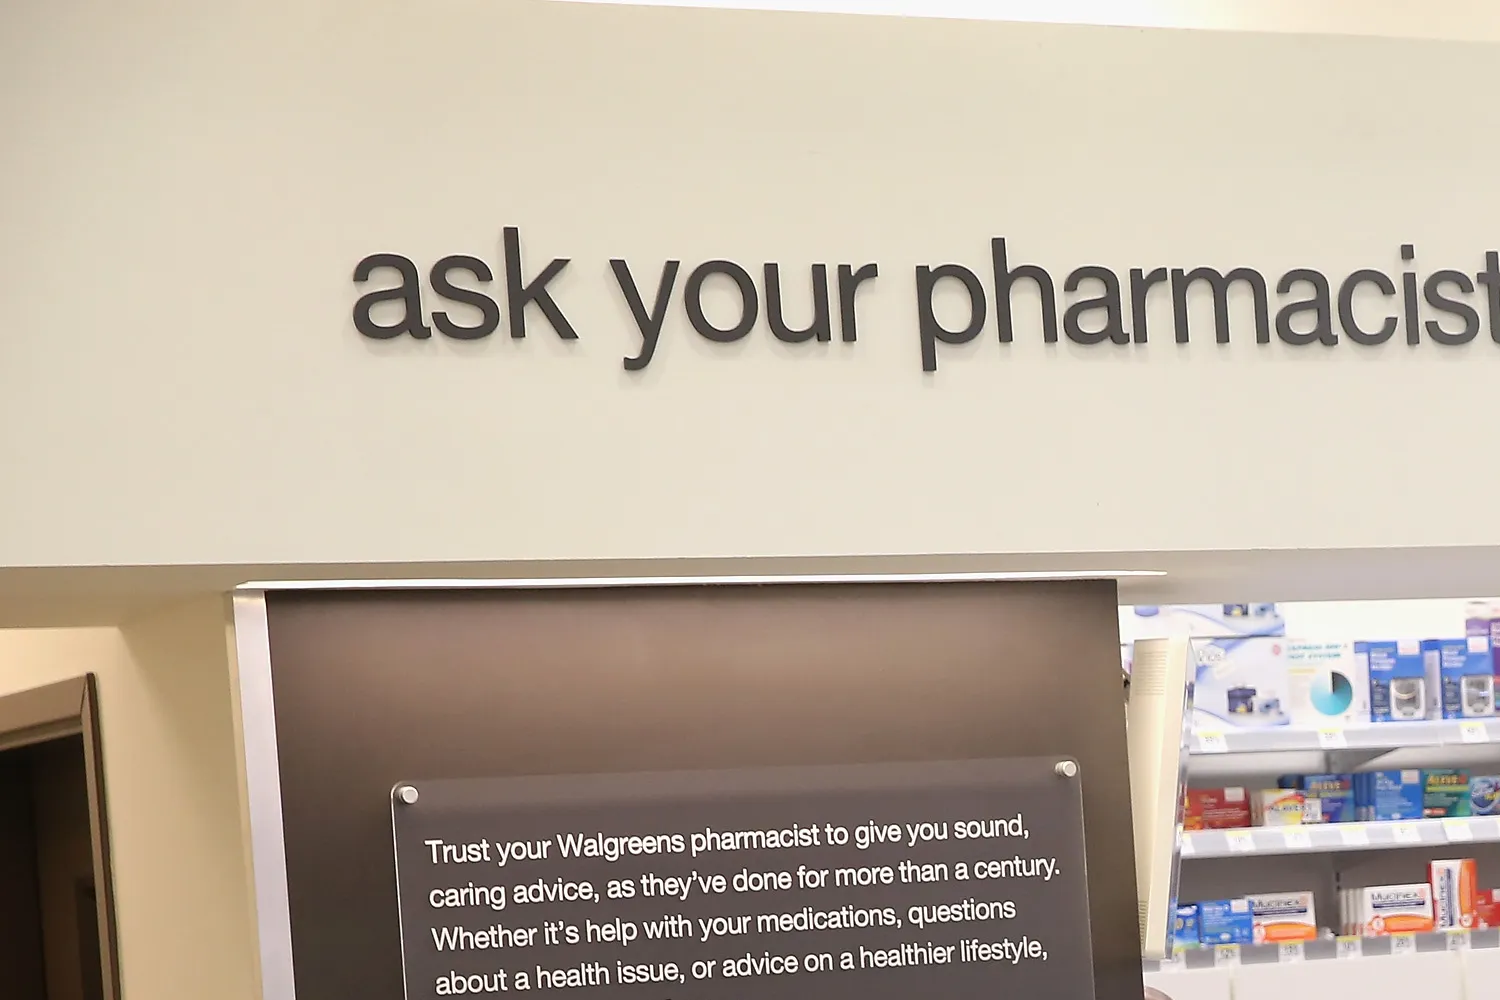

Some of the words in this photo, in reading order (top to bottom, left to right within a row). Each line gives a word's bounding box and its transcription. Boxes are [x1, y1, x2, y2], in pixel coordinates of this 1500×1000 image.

[352, 226, 579, 342] ask
[608, 259, 879, 372] your
[424, 838, 491, 864] Trust
[495, 839, 552, 867] your
[556, 832, 686, 862] Walgreens
[690, 823, 821, 858] pharmacist
[824, 823, 849, 845] to
[854, 819, 902, 850] give
[905, 822, 948, 847] you
[953, 813, 1029, 840] sound,
[429, 881, 506, 911] caring
[513, 877, 600, 904] advice,
[607, 879, 636, 899] as
[639, 870, 727, 901] they've
[732, 868, 793, 892] done
[796, 865, 830, 889] for
[834, 866, 895, 887] more
[897, 859, 949, 883] than
[954, 862, 970, 881] a
[973, 855, 1060, 881] century.
[430, 923, 538, 951] Whether
[543, 920, 580, 945] it's
[585, 917, 638, 947] help
[642, 914, 693, 939] with
[698, 915, 752, 942] your
[757, 904, 902, 933] medications,
[907, 897, 1017, 929] questions
[435, 968, 509, 995] about
[514, 971, 531, 991] a
[536, 961, 610, 989] health
[616, 960, 685, 984] issue,
[691, 960, 717, 979] or
[722, 951, 799, 977] advice
[803, 953, 834, 972] on
[839, 952, 855, 970] a
[859, 941, 956, 969] healthier
[960, 935, 1048, 965] lifestyle,
